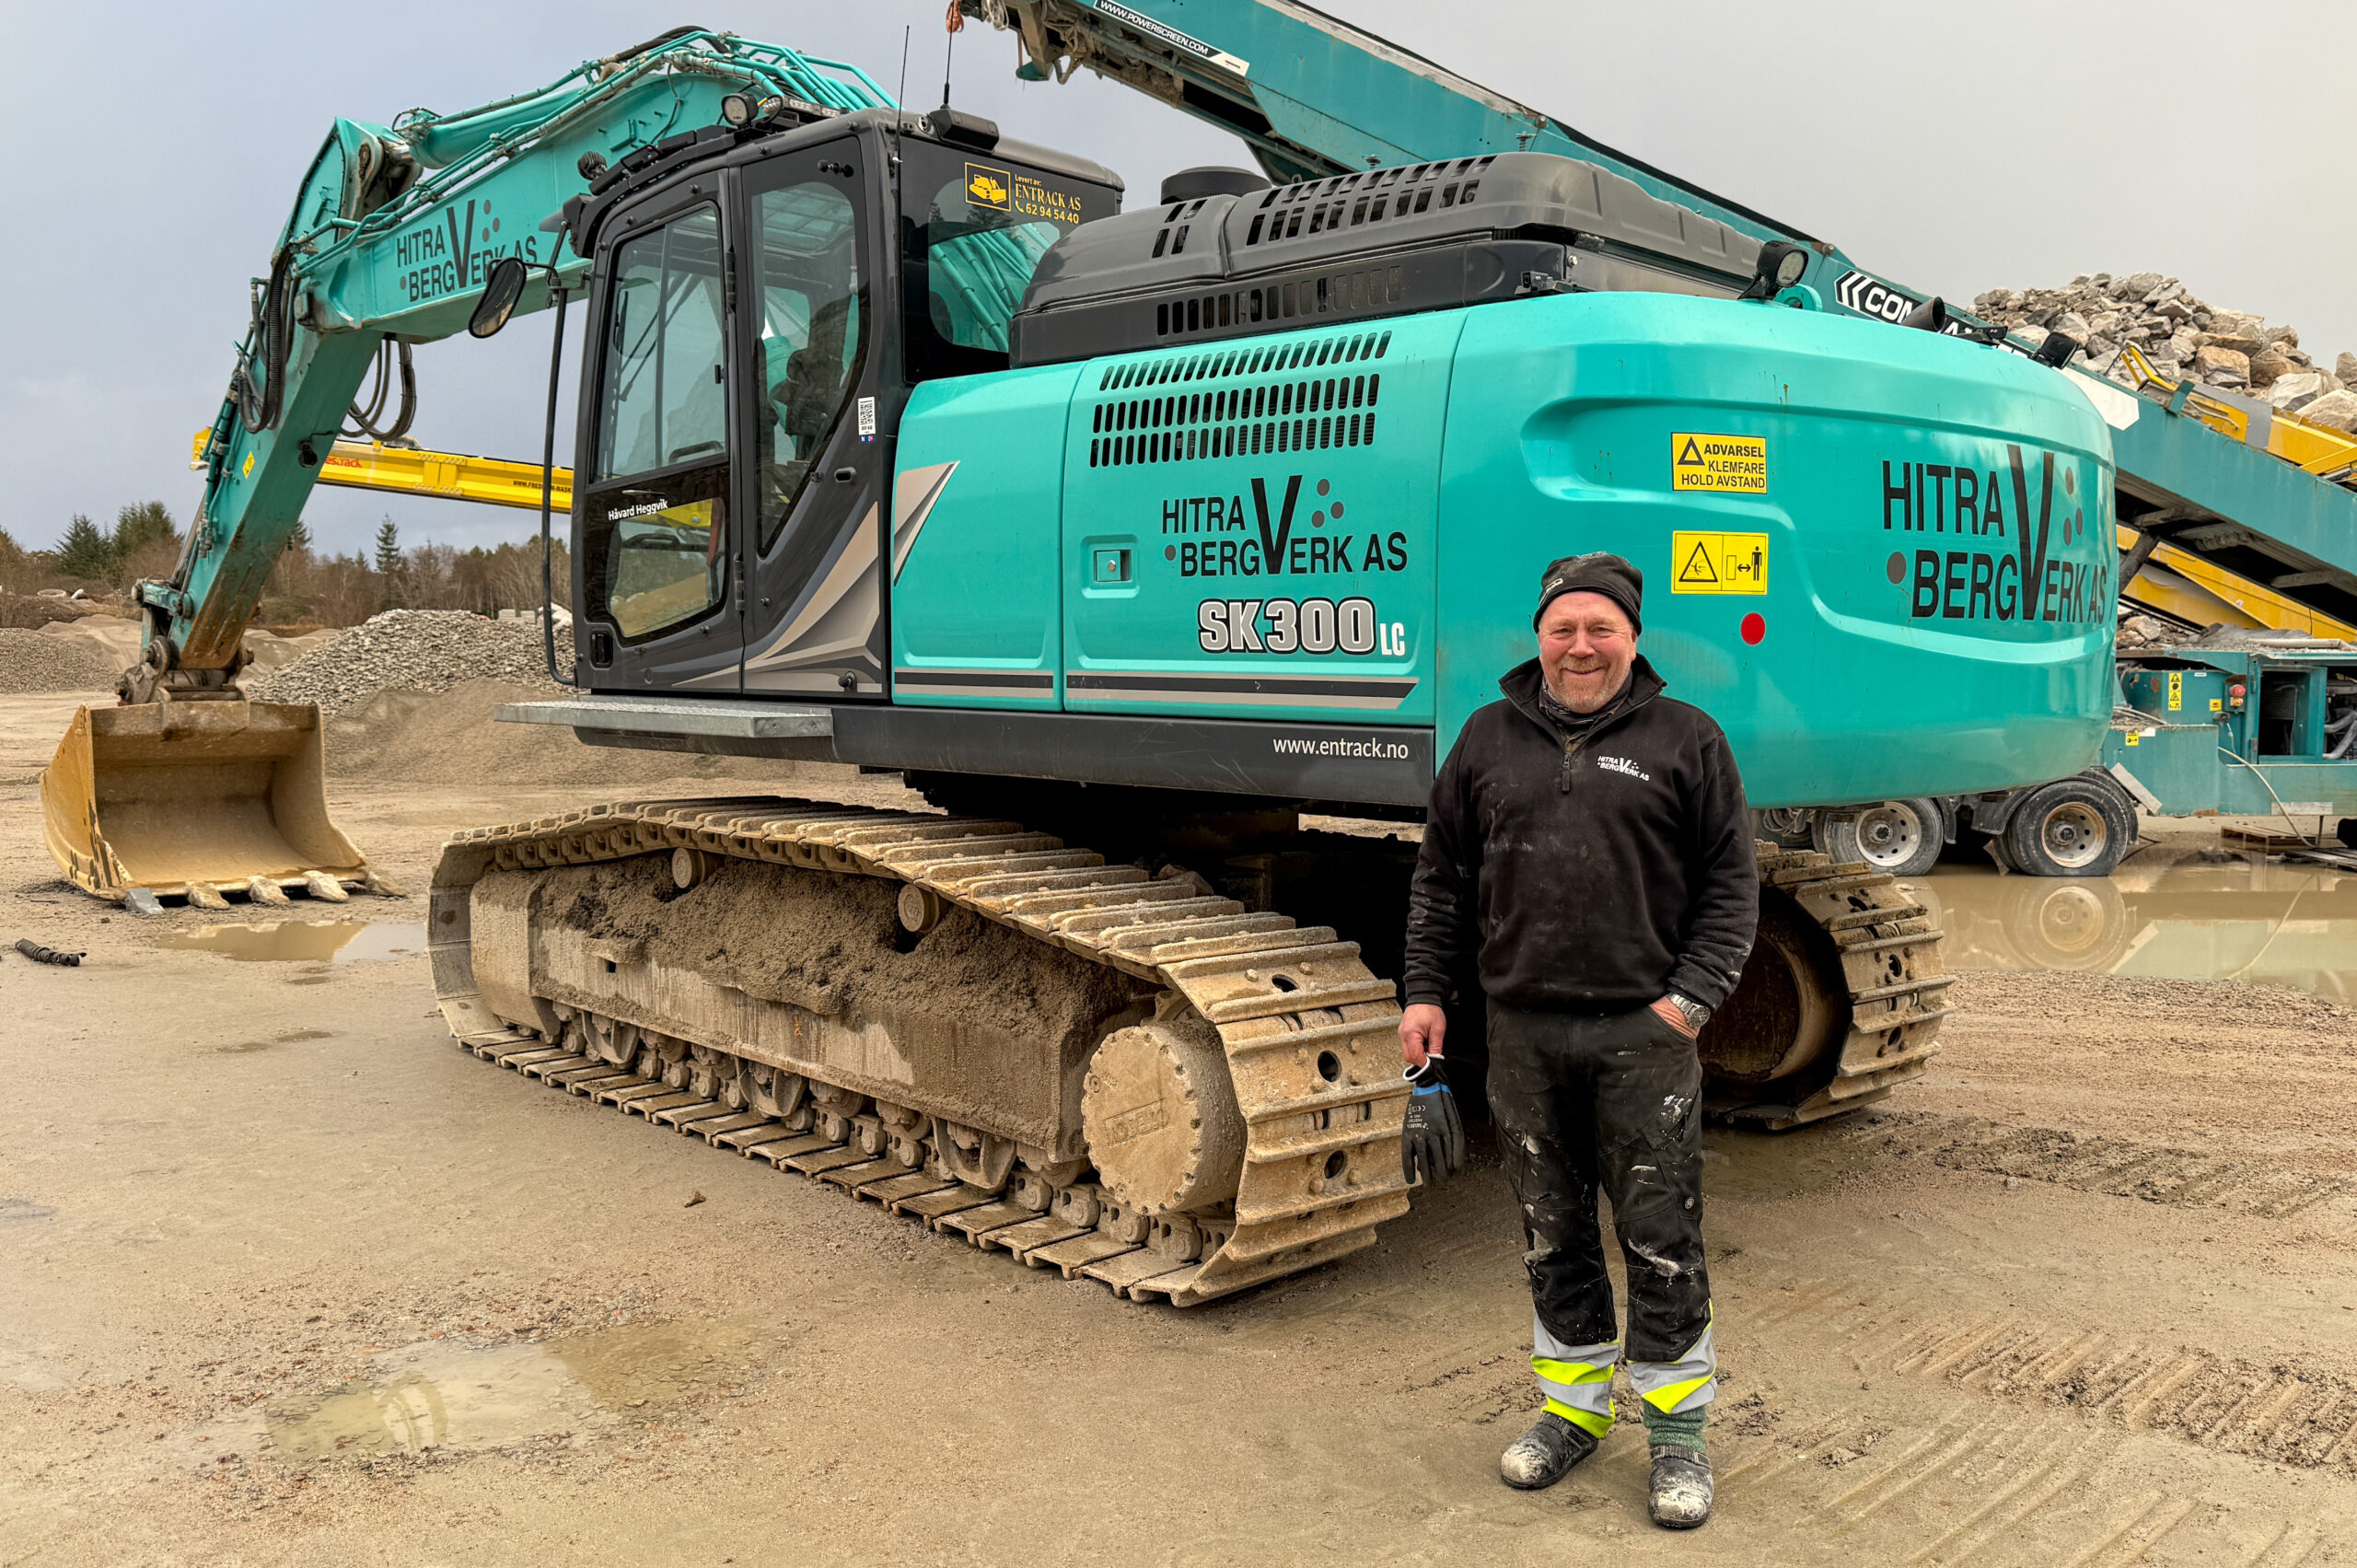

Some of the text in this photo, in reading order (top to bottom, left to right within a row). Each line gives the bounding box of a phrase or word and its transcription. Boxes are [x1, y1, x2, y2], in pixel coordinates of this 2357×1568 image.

[1100, 1, 1209, 55] WWW.POWERSCREEN.COM
[1015, 173, 1033, 185] Levert
[1015, 183, 1082, 211] ENTRACK AS
[1026, 203, 1079, 224] 62 94 54 40
[397, 225, 446, 268] HITRA
[1704, 444, 1764, 458] ADVARSEL
[1708, 460, 1764, 474] KLEMFARE
[1681, 473, 1765, 488] HOLD AVSTAND
[609, 498, 668, 521] Håvard Heggvik
[1883, 460, 2005, 537] HITRA
[1162, 495, 1246, 534] HITRA
[1363, 531, 1408, 572] AS
[2087, 564, 2107, 624] AS
[1198, 597, 1406, 656] SK300 LC
[1273, 738, 1409, 759] www.entrack.no
[1597, 756, 1619, 764] HITRA
[1639, 772, 1650, 781] AS
